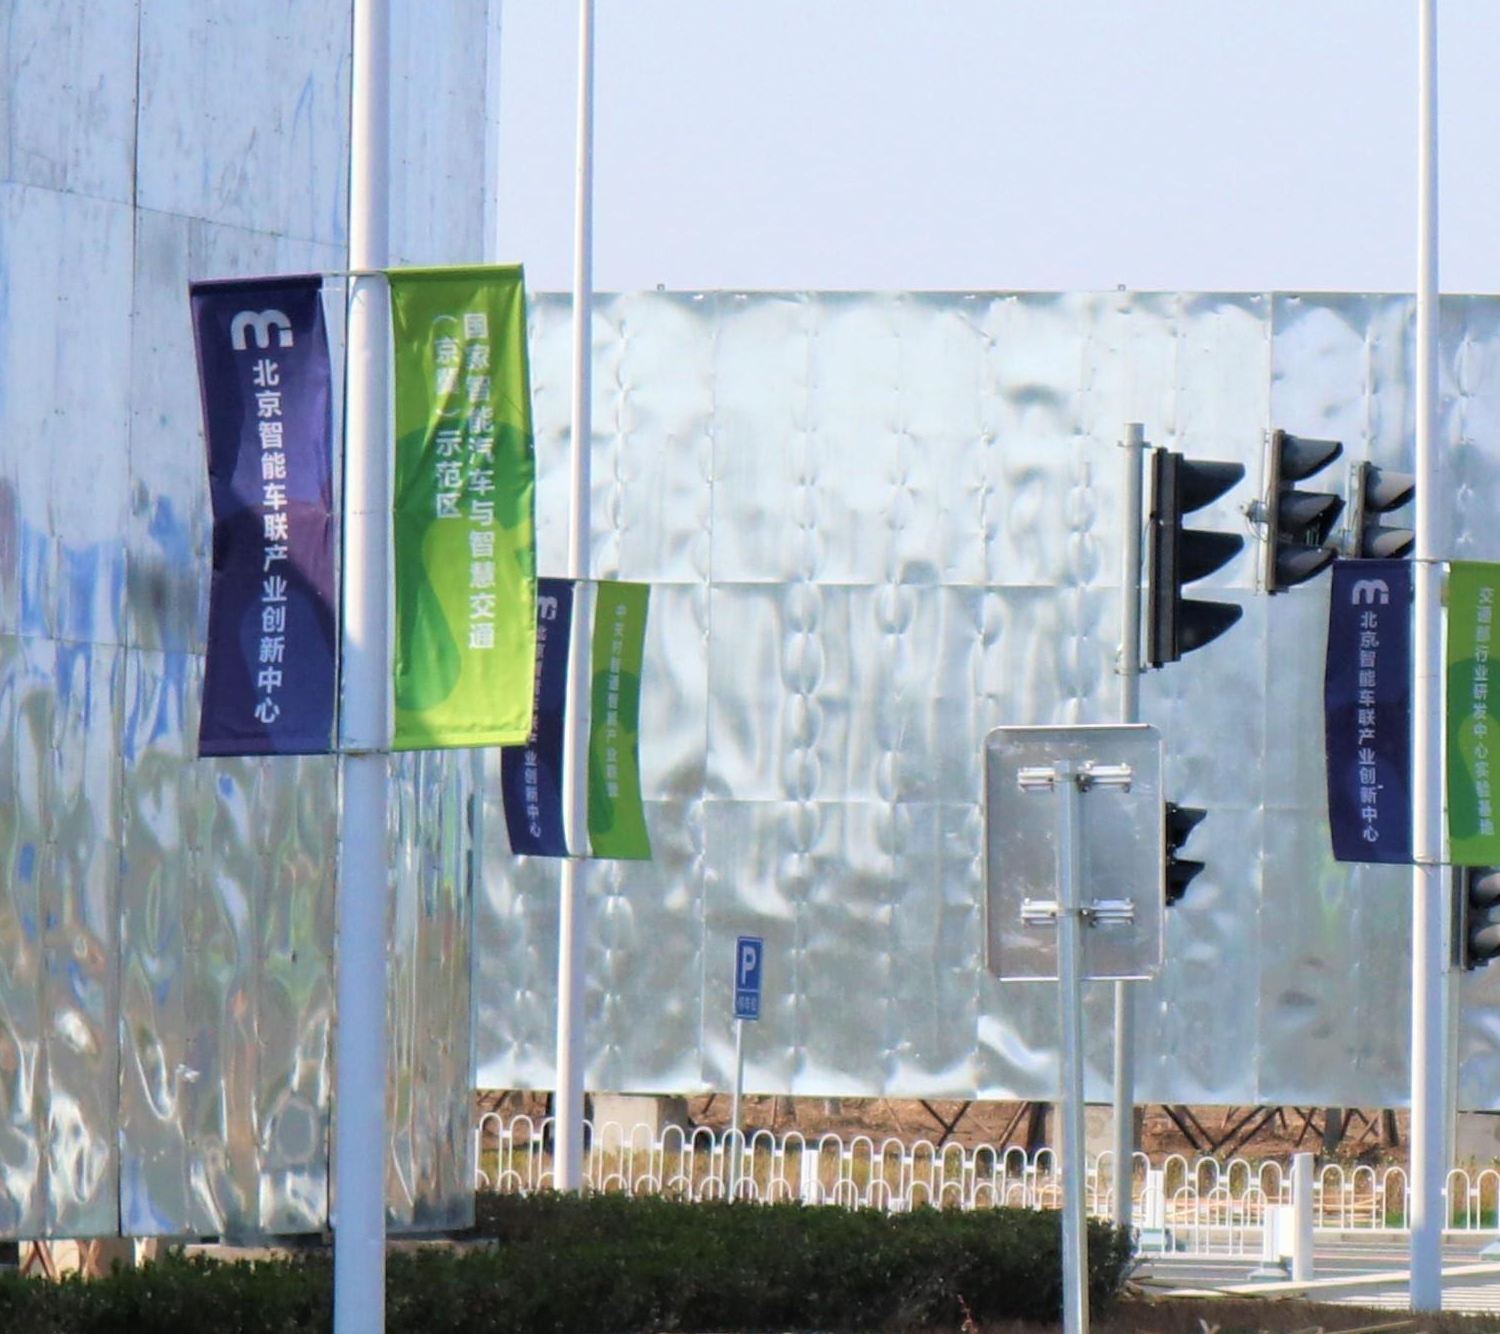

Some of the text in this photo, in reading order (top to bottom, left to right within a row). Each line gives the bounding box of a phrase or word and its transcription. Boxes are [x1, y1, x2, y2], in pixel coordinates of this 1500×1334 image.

[252, 358, 290, 725] 北京智能车联产业创新中心
[463, 312, 497, 651] 国家智能汽车与智慧交通
[1357, 610, 1380, 843] 北京智能车联产业创新中心
[741, 946, 756, 985] P
